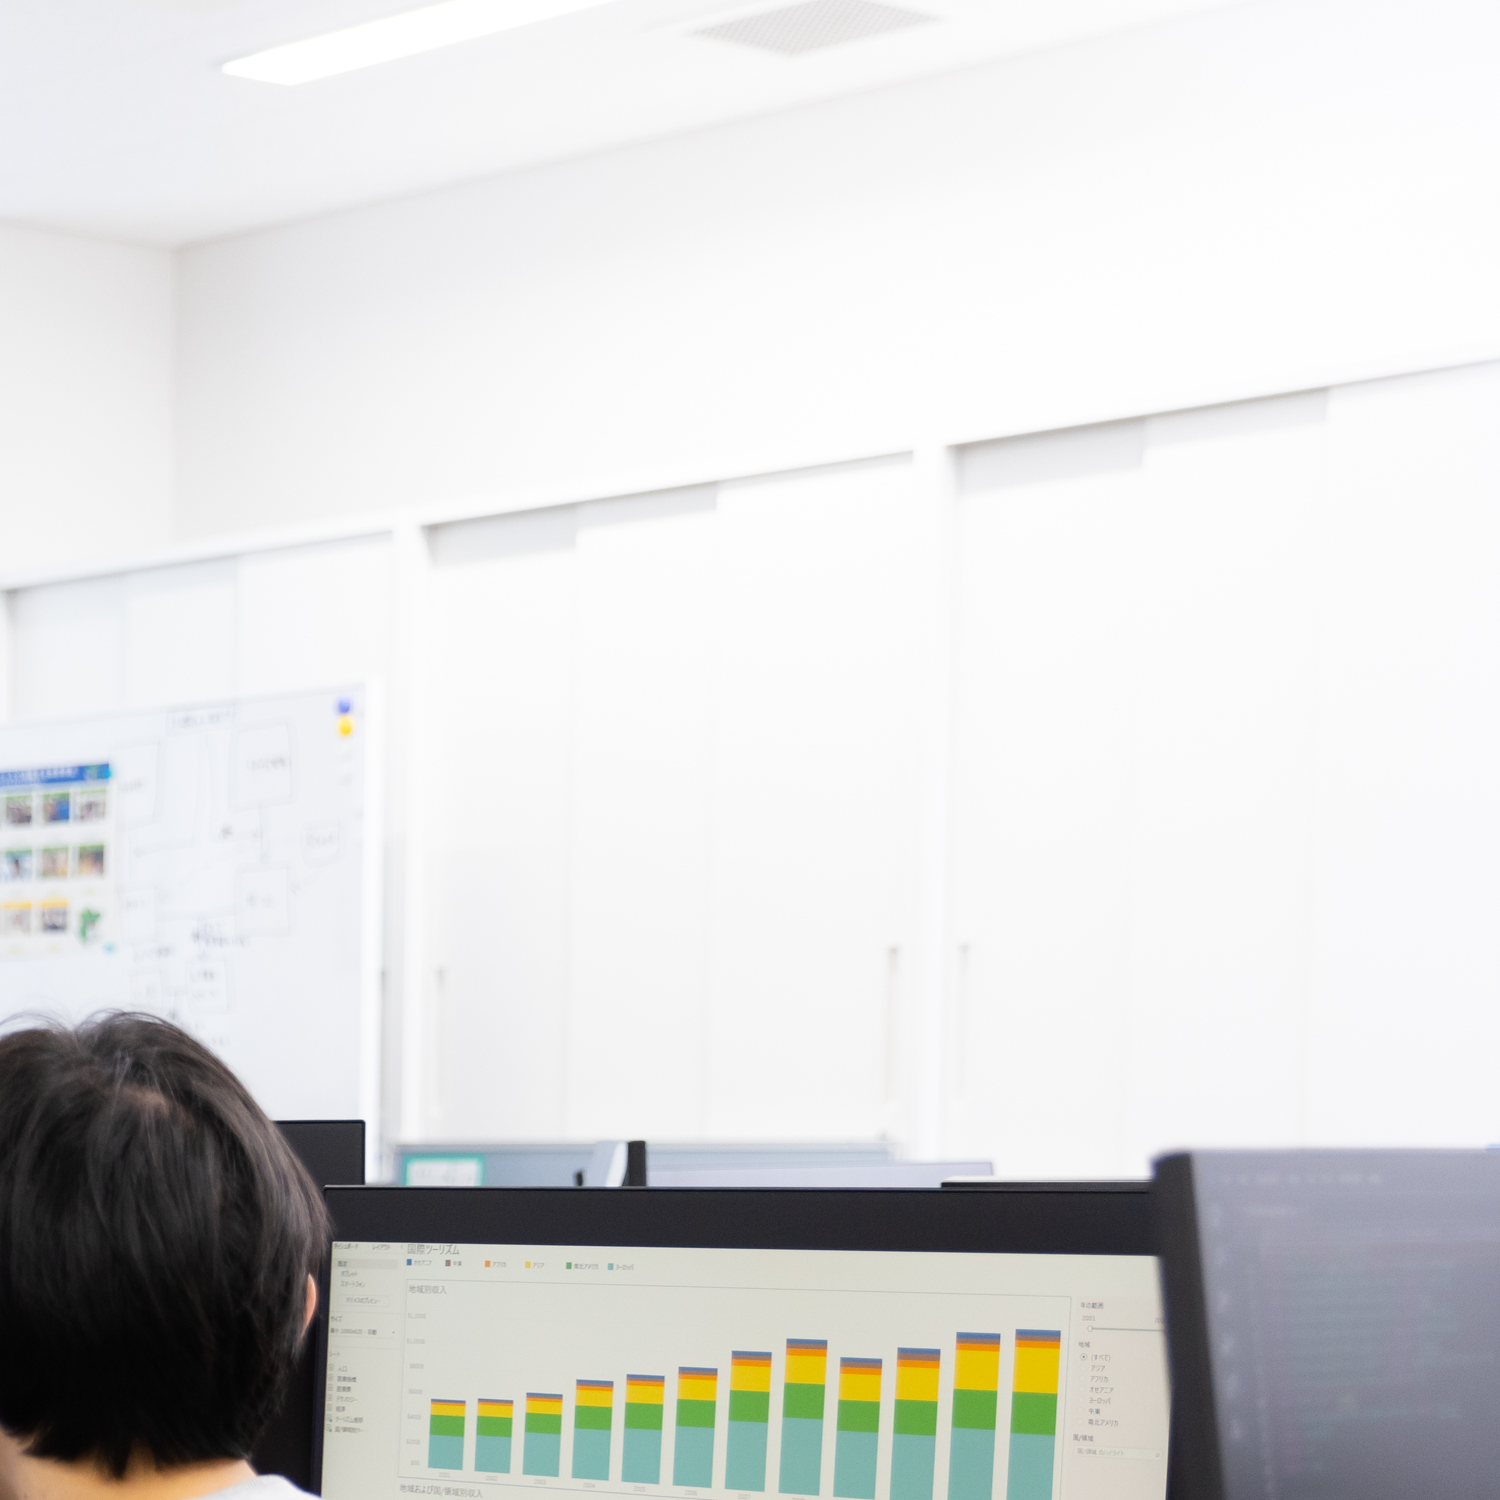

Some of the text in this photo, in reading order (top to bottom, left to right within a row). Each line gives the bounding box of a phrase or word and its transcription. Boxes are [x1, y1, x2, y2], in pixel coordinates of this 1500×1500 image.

[407, 1243, 460, 1255] 国際ツーリズム
[408, 1284, 447, 1294] 地域別収入
[1090, 1375, 1108, 1383] アフリカ
[1089, 1386, 1114, 1394] オセアニア
[1088, 1397, 1111, 1405] ヨーロッパ
[1087, 1418, 1119, 1427] 南北アメリカ
[399, 1483, 484, 1499] 地域および国/領域別収入
